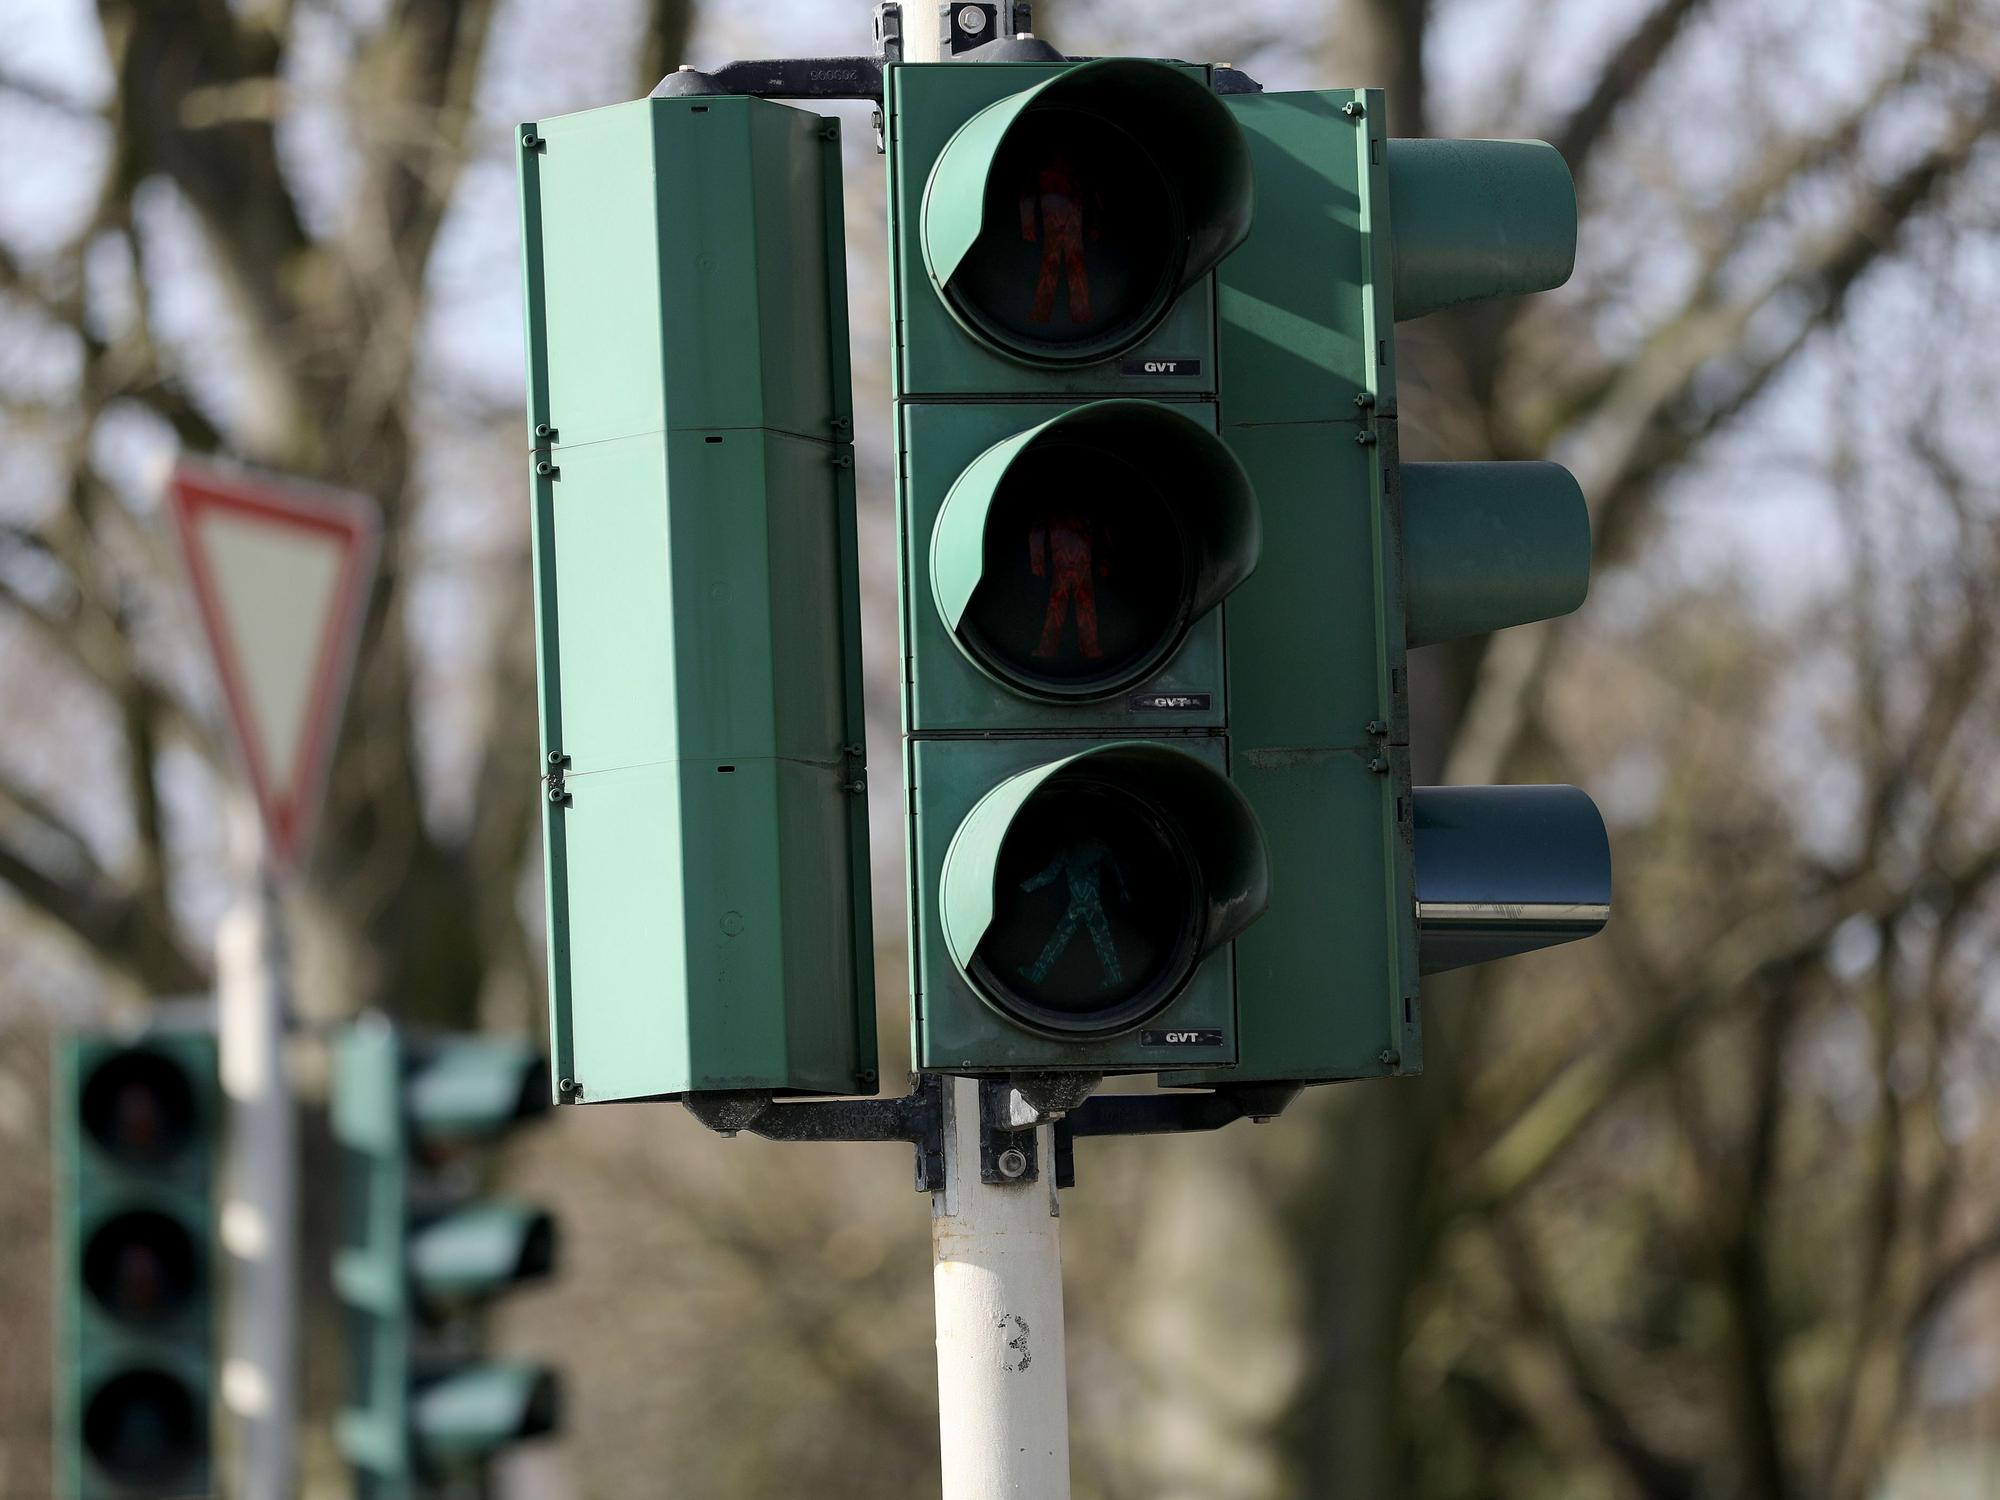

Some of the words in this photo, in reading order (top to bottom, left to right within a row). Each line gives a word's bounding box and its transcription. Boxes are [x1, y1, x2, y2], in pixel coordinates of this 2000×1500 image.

[1144, 362, 1177, 373] GVT
[1154, 697, 1187, 707] GVT
[1165, 1032, 1199, 1043] GVT
